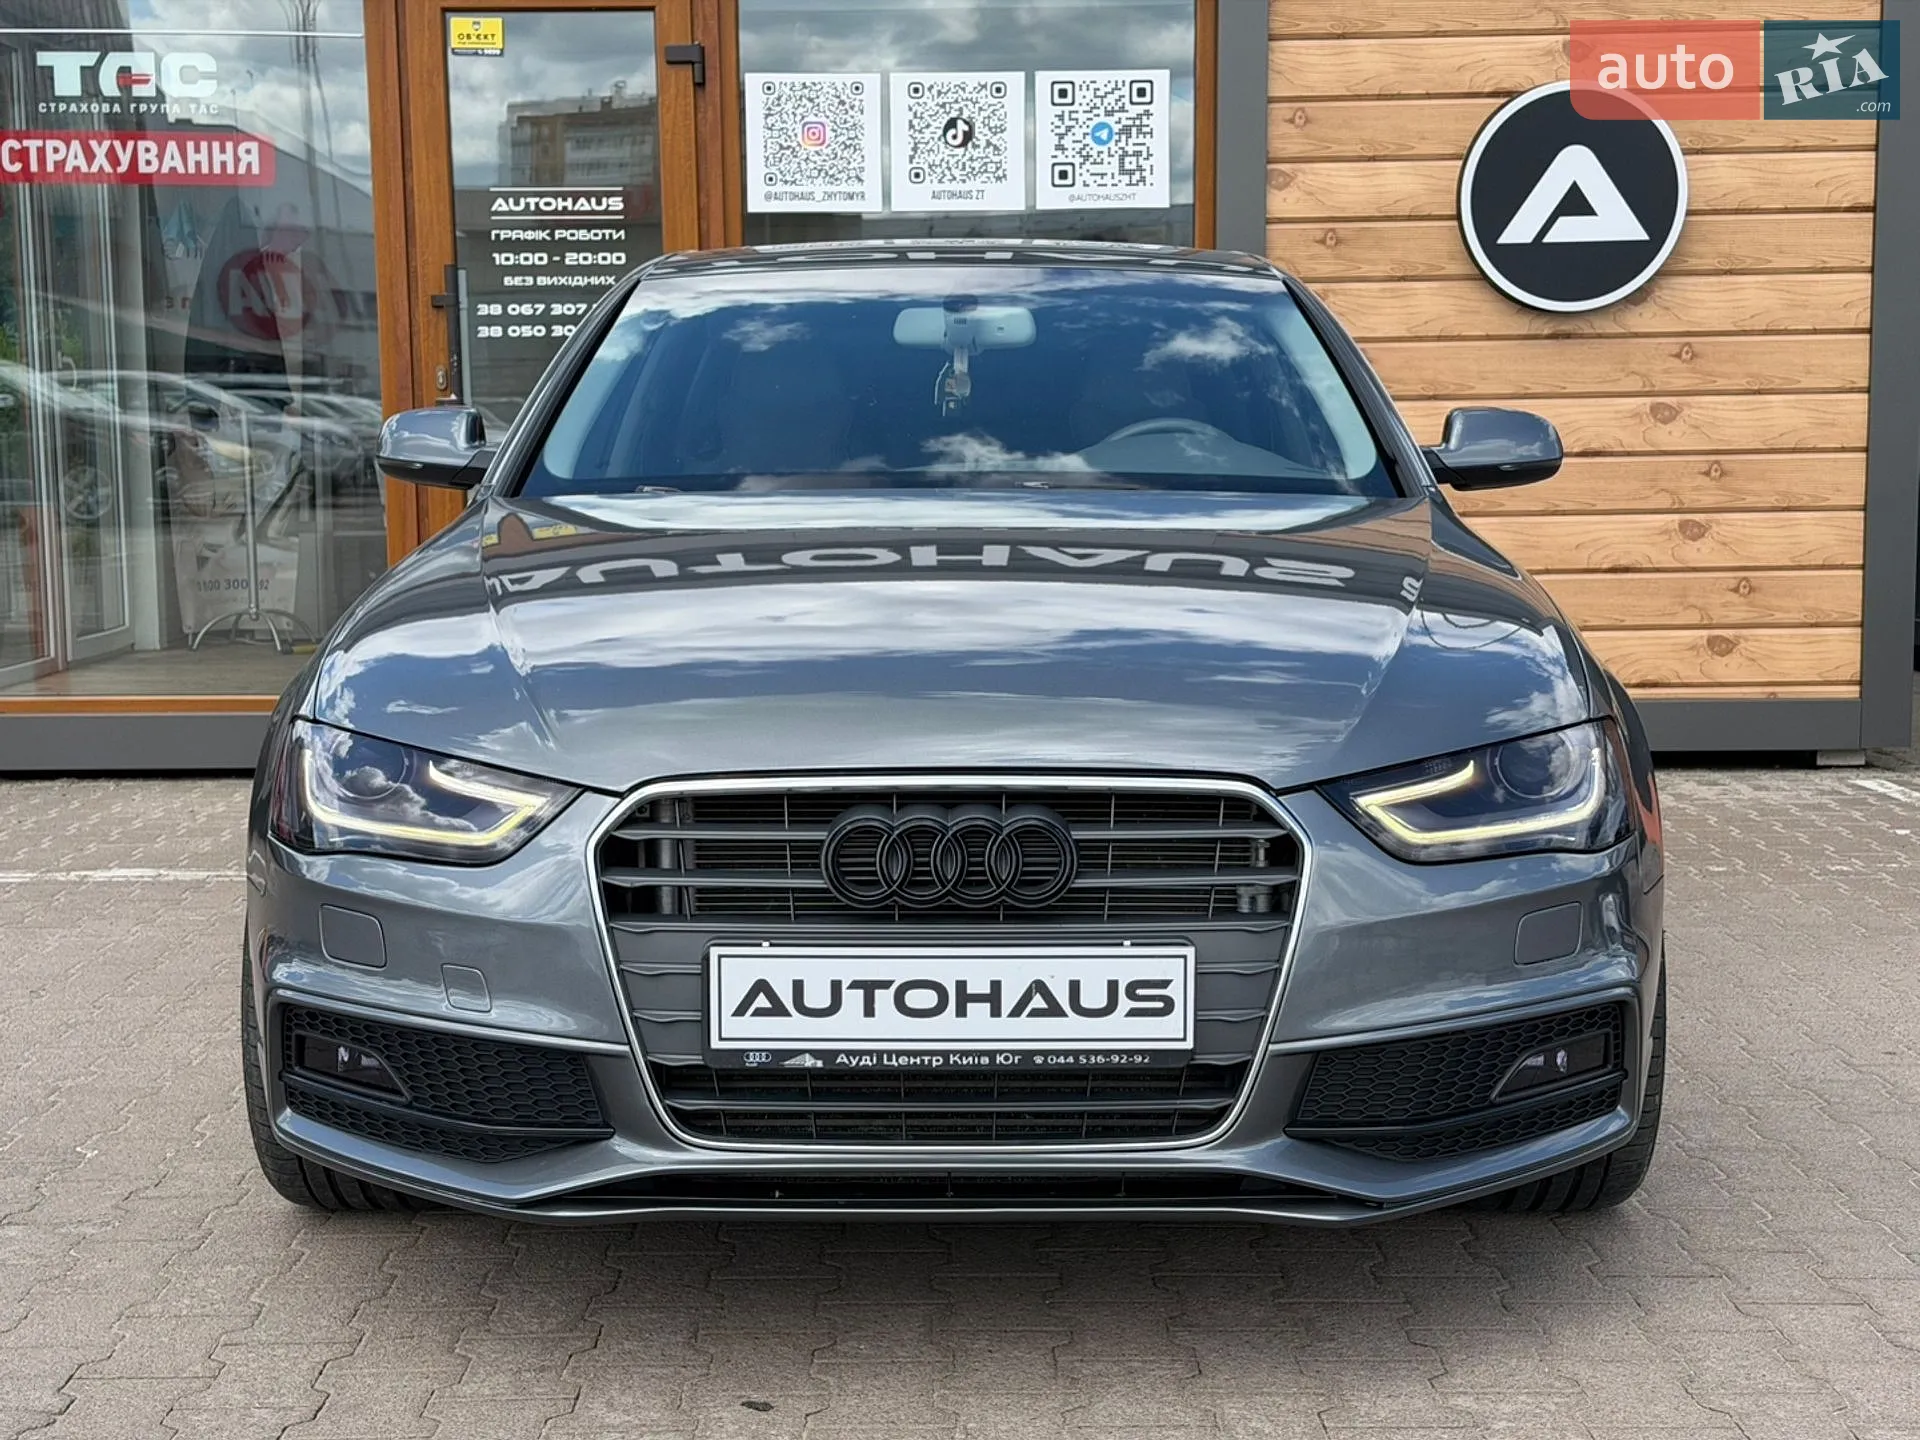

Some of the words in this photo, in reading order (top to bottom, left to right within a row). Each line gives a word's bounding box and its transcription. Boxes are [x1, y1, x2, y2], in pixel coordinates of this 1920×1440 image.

[38, 102, 121, 114] СТРАХОВА
[130, 103, 181, 114] ГРУПА
[189, 103, 219, 115] ТАС
[1, 139, 260, 175] СТРАХУВАННЯ
[764, 190, 866, 202] @AUTOHAUS_ZHYTOMYR
[930, 189, 973, 200] AUTOHAUS
[975, 189, 985, 200] ZT
[490, 197, 624, 211] AUTOHAUS
[491, 229, 552, 241] ГРАФІК
[555, 229, 626, 241] РОБОТИ
[492, 252, 548, 265] 10:00
[564, 252, 626, 265] 20:00
[503, 276, 534, 286] БЕЗ
[537, 275, 616, 288] ВИХІДНИХ
[476, 303, 503, 315] 38
[507, 303, 546, 315] 067
[550, 303, 587, 315] 307
[476, 326, 503, 338] 38
[507, 325, 546, 337] 050
[730, 977, 1176, 1019] AUTOHAUS
[835, 1052, 877, 1067] Ауді
[882, 1053, 944, 1068] Центр
[949, 1052, 990, 1065] Київ
[996, 1052, 1022, 1065] Юг
[1047, 1054, 1074, 1064] 044
[1079, 1054, 1150, 1064] 536-92-92
